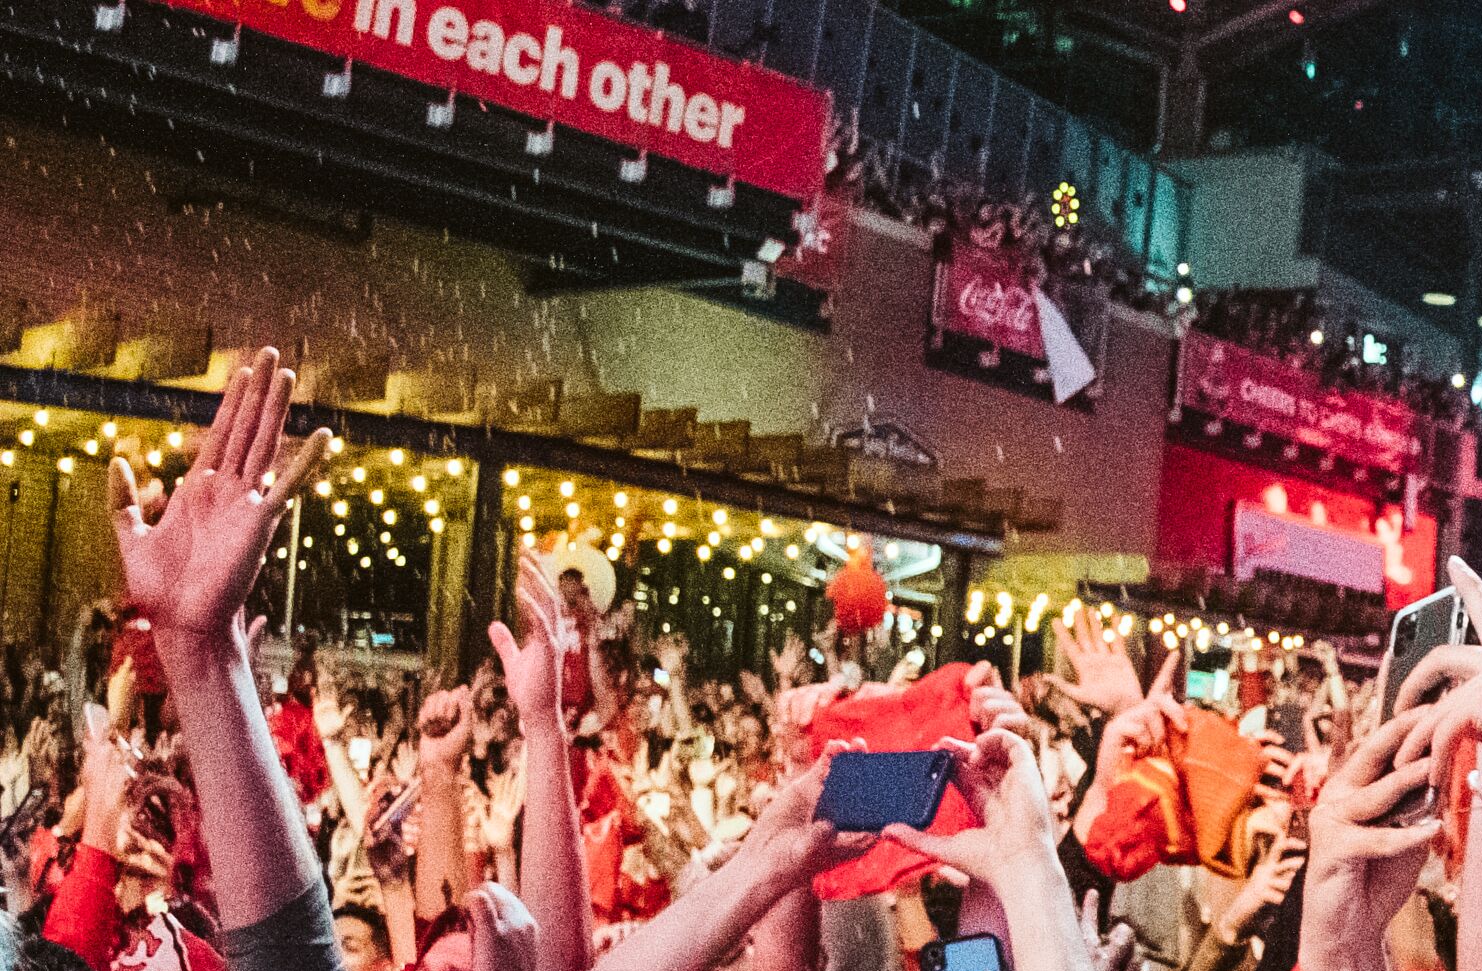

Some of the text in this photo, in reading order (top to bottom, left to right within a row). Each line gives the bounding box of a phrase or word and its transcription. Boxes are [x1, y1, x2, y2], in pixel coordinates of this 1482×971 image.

[354, 0, 746, 149] in each other
